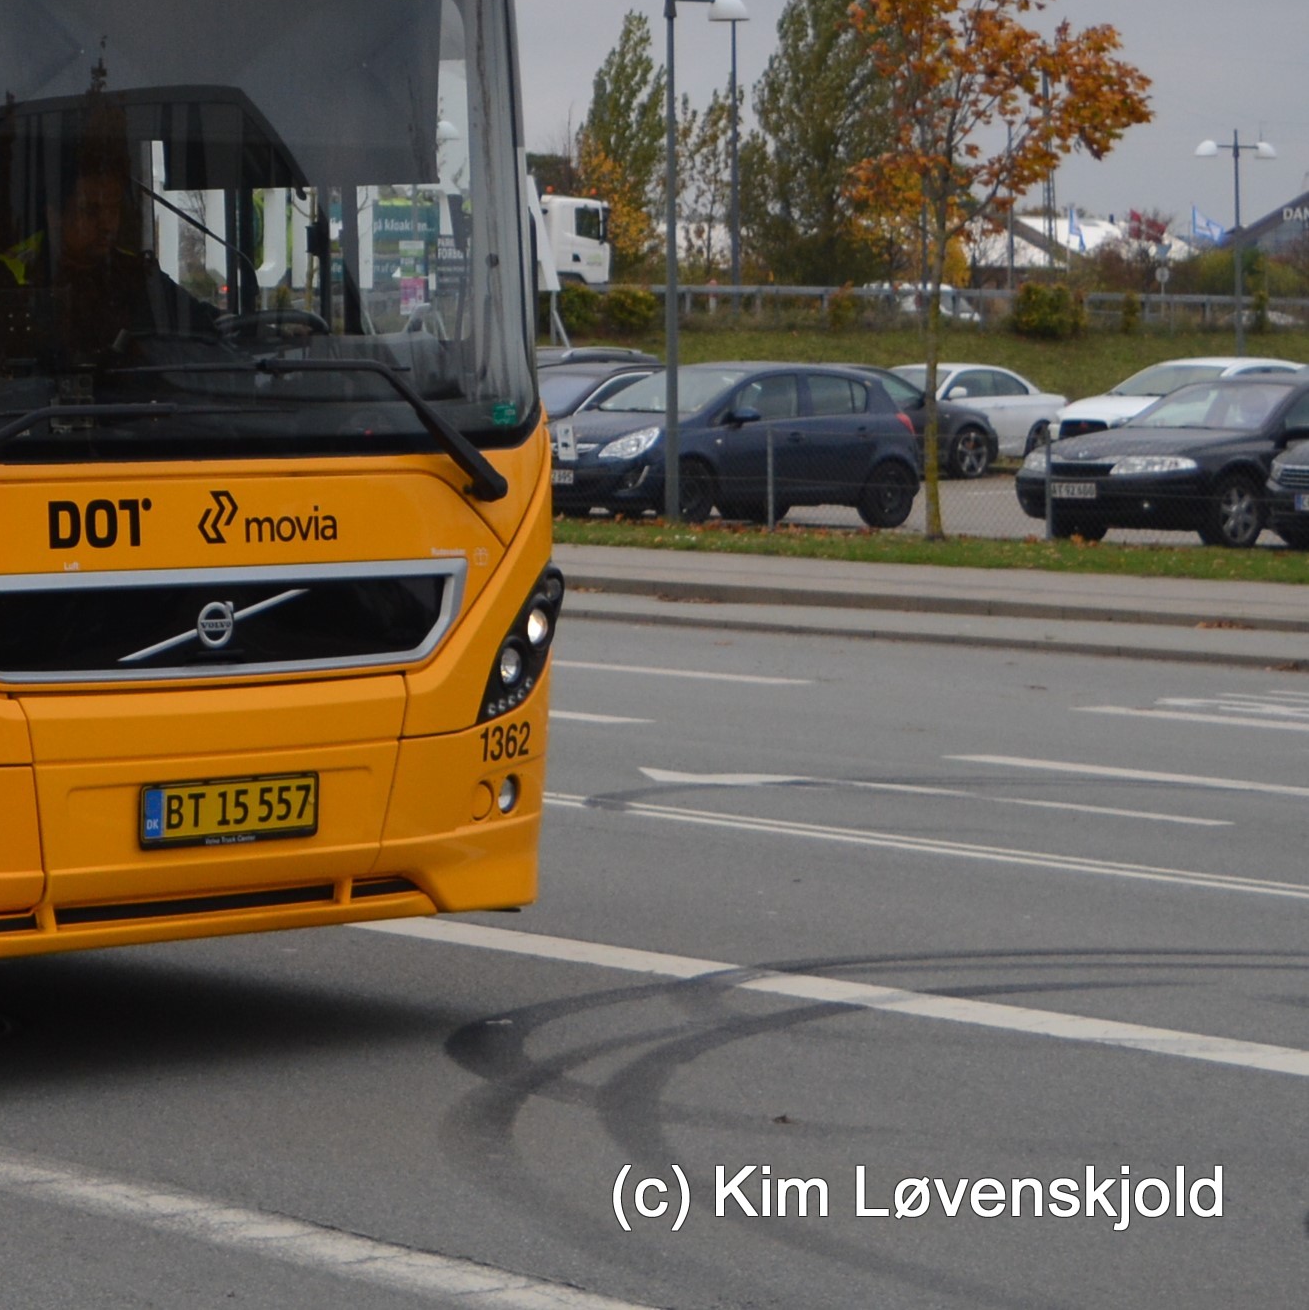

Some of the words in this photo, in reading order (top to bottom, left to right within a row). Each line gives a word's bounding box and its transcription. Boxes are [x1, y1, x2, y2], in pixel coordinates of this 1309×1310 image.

[48, 498, 152, 550] DOT
[244, 505, 339, 544] movia
[200, 621, 232, 629] VOLVO
[479, 722, 531, 763] 1362
[146, 819, 159, 830] DK
[166, 792, 206, 830] BT
[217, 789, 249, 826] 15
[257, 784, 311, 823] 557
